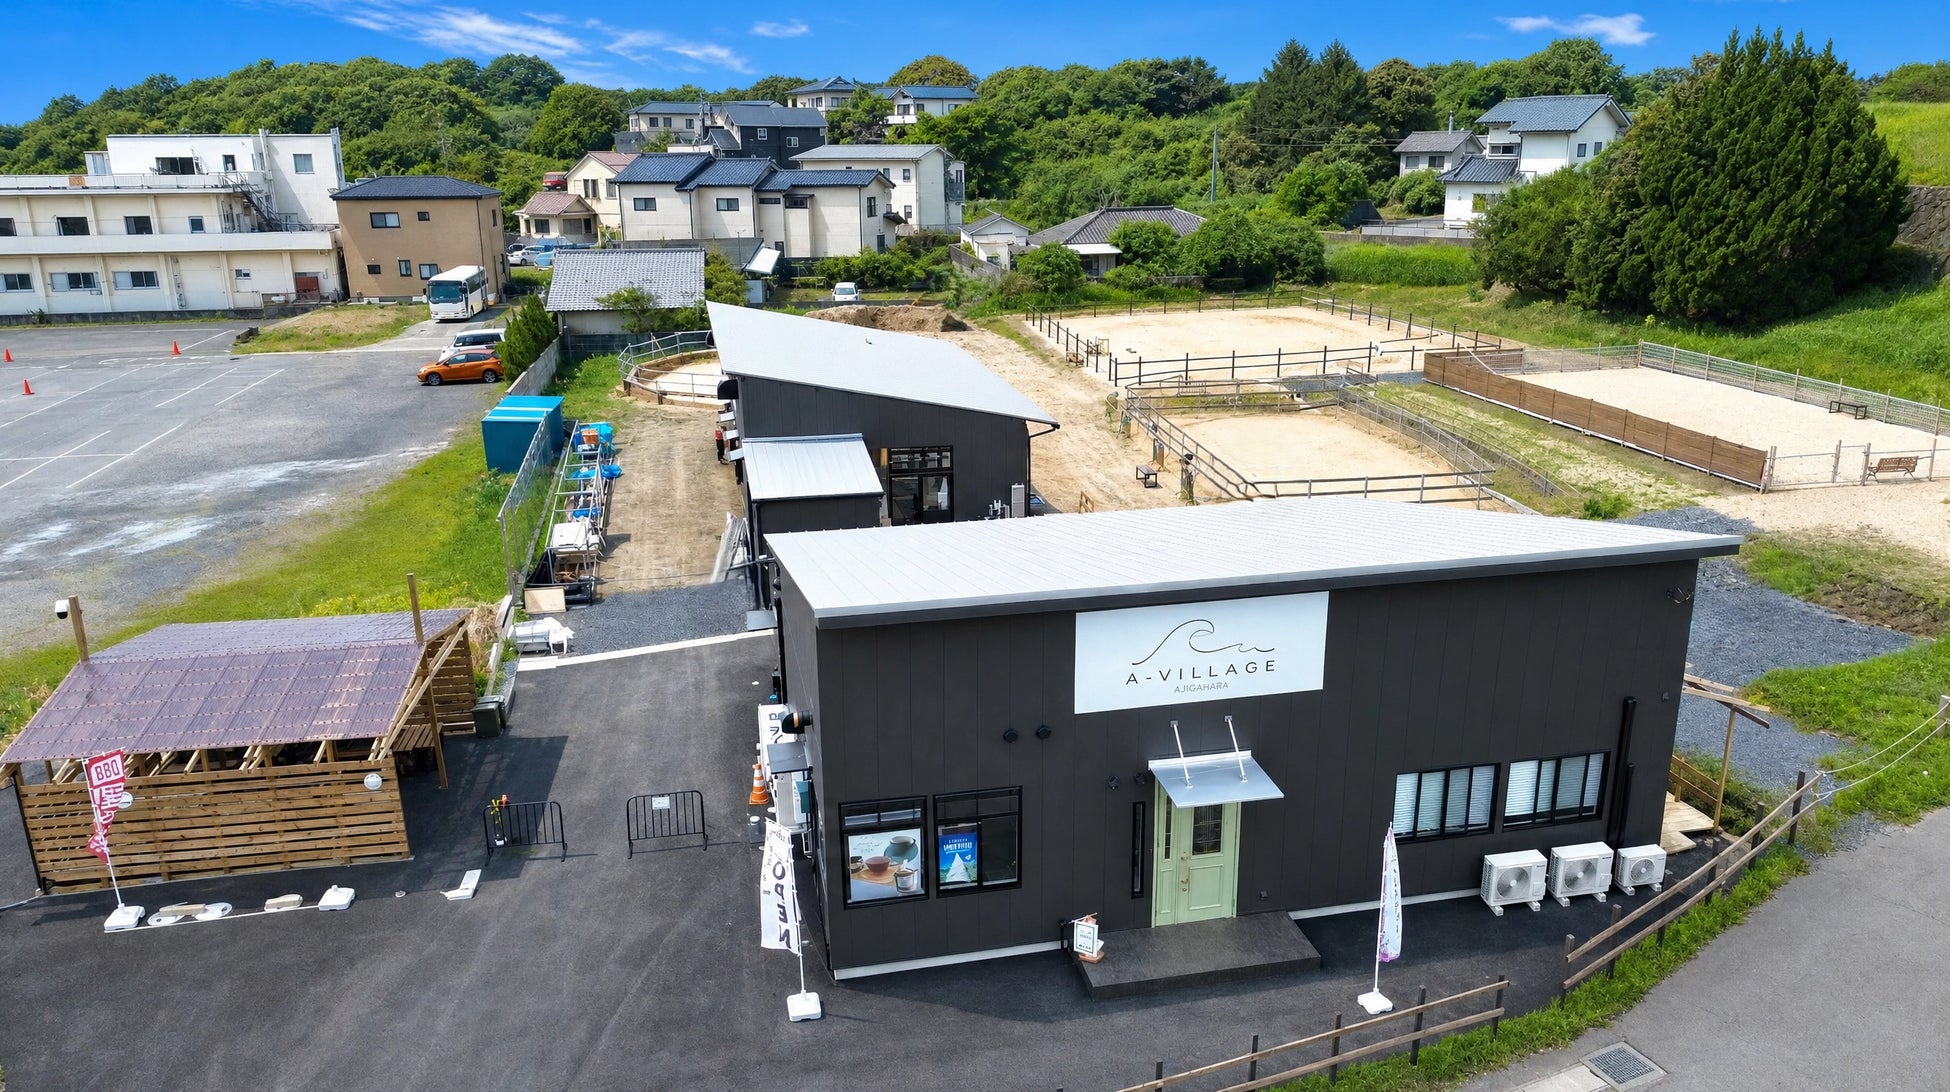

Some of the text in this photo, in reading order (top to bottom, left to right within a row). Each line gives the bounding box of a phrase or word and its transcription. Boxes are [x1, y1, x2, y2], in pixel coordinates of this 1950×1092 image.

[1125, 659, 1275, 686] A-VILLAGE
[1173, 681, 1229, 694] AJIGAHARA
[95, 759, 120, 781] BBQ
